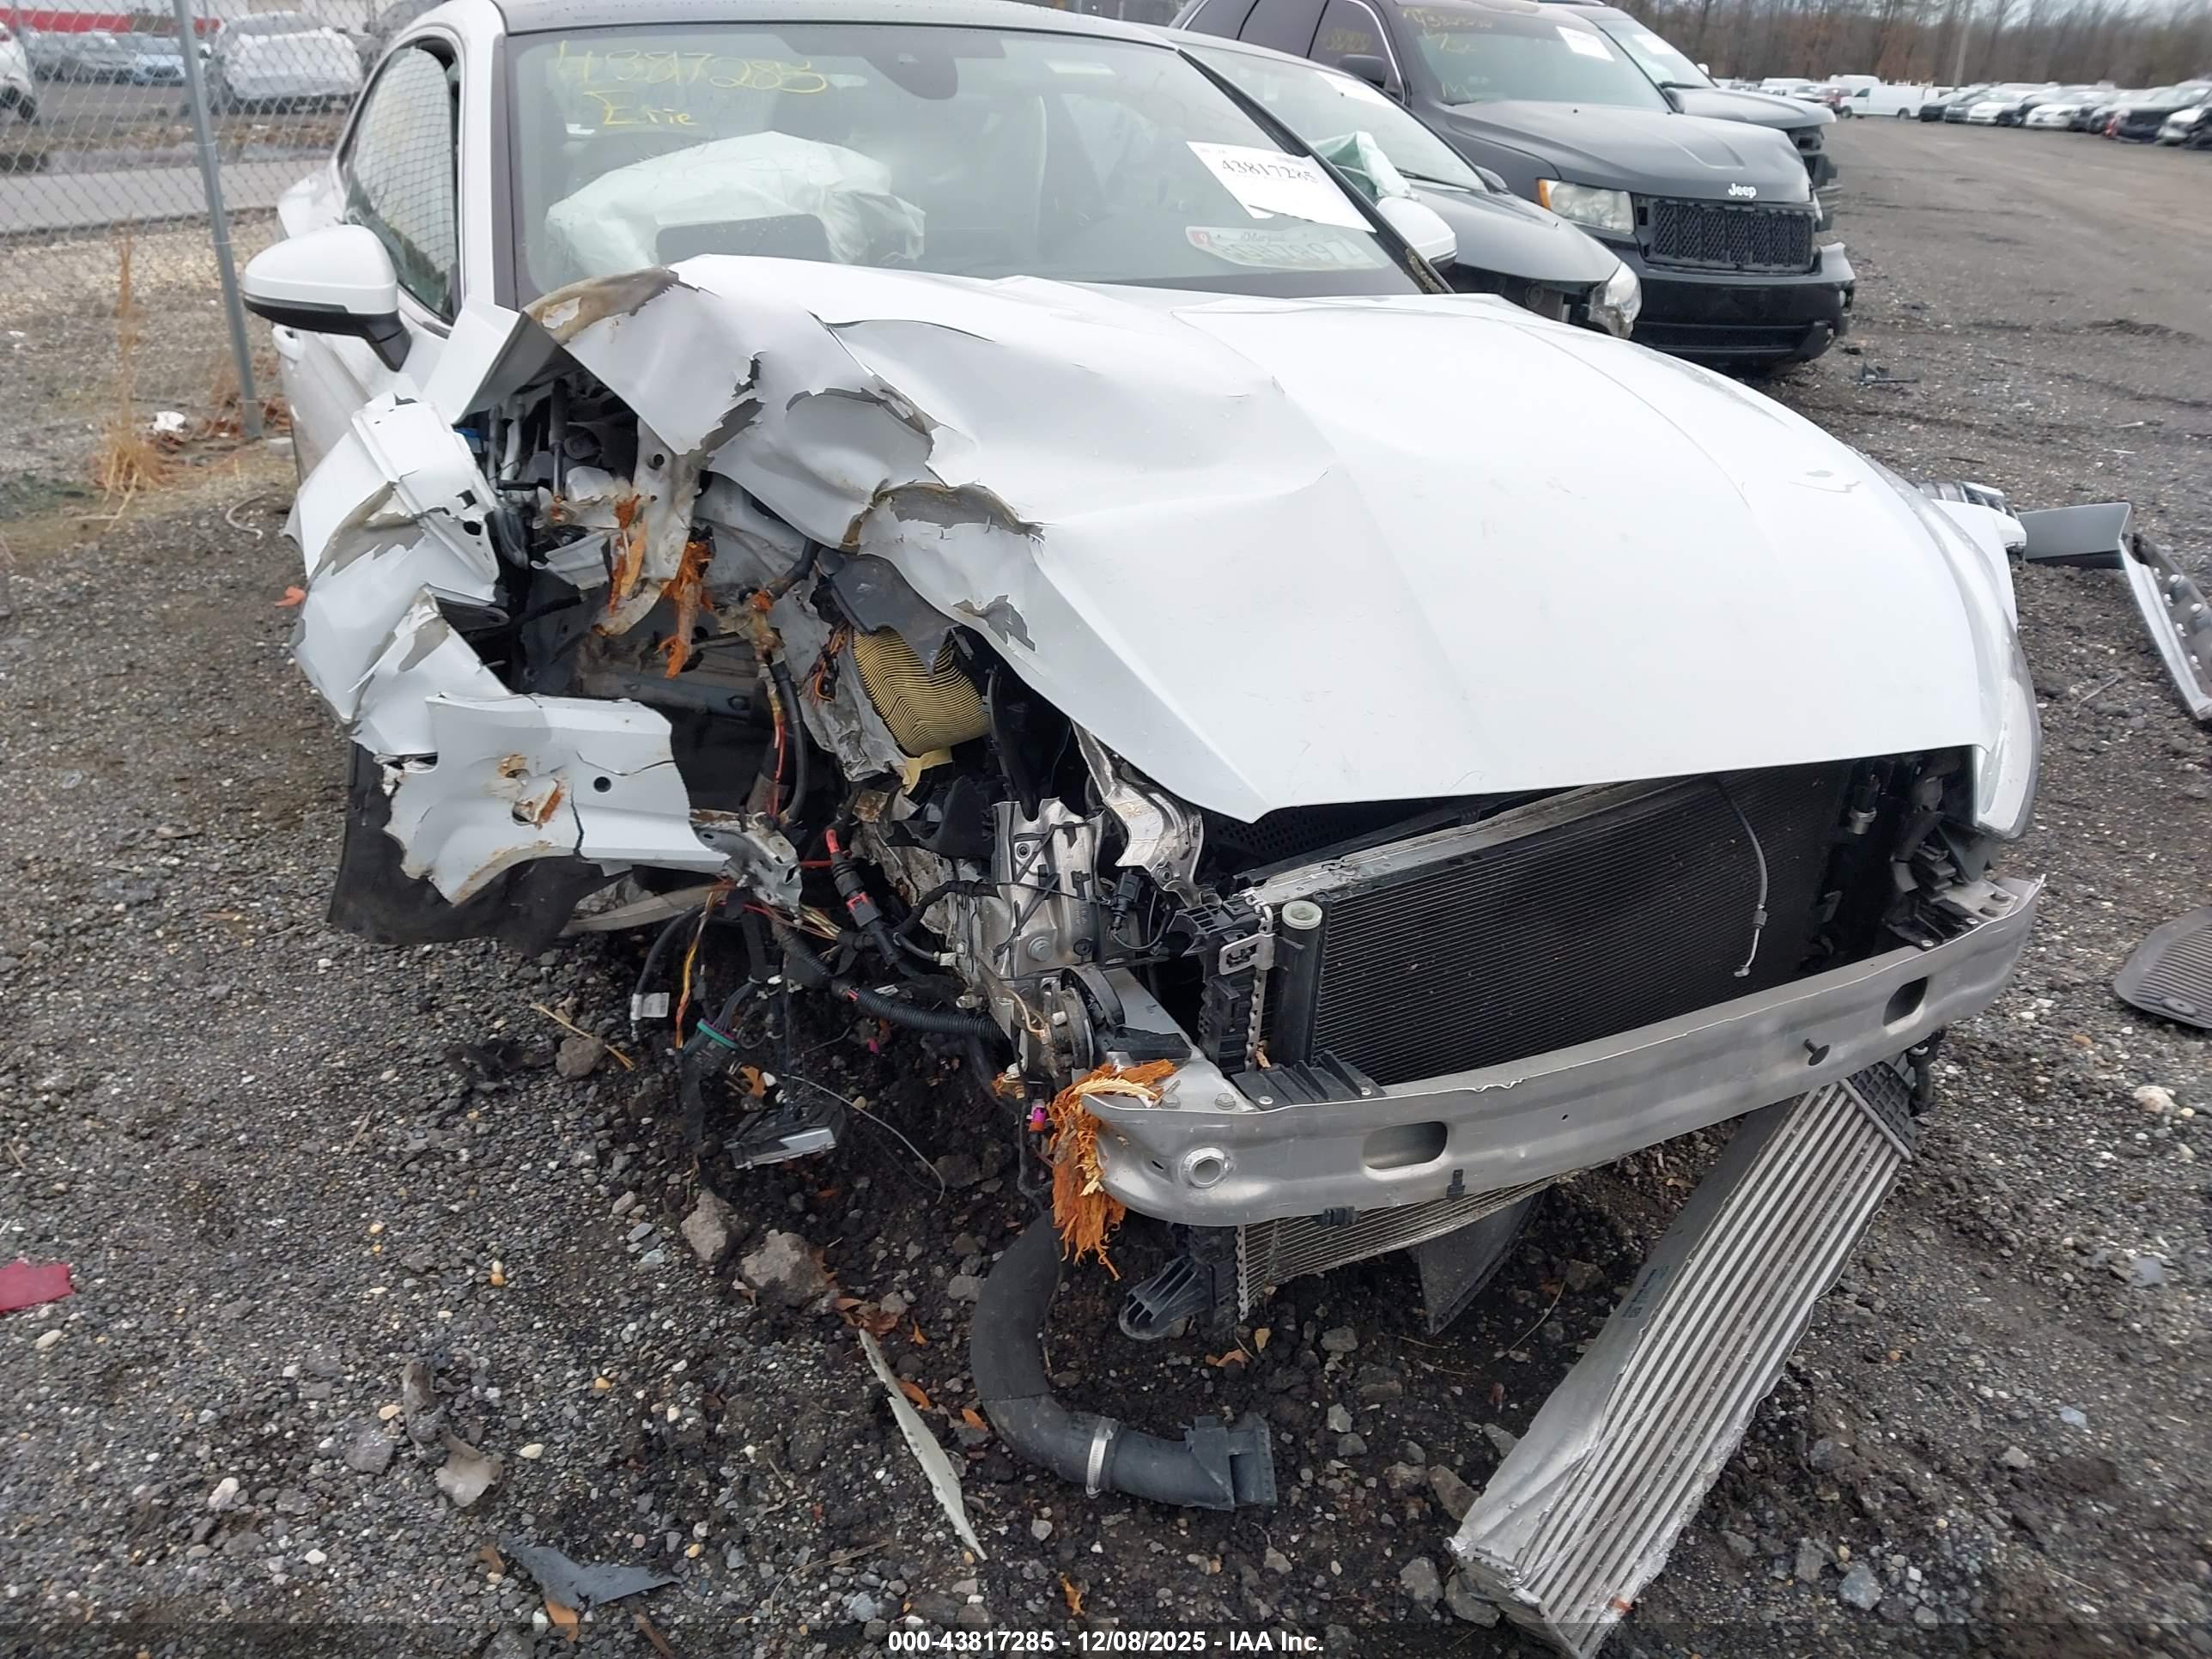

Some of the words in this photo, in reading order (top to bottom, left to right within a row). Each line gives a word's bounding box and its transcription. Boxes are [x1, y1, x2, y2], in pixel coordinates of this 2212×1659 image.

[583, 89, 699, 125] Erie
[1222, 159, 1320, 185] 43817285
[1728, 182, 1757, 198] Jeep
